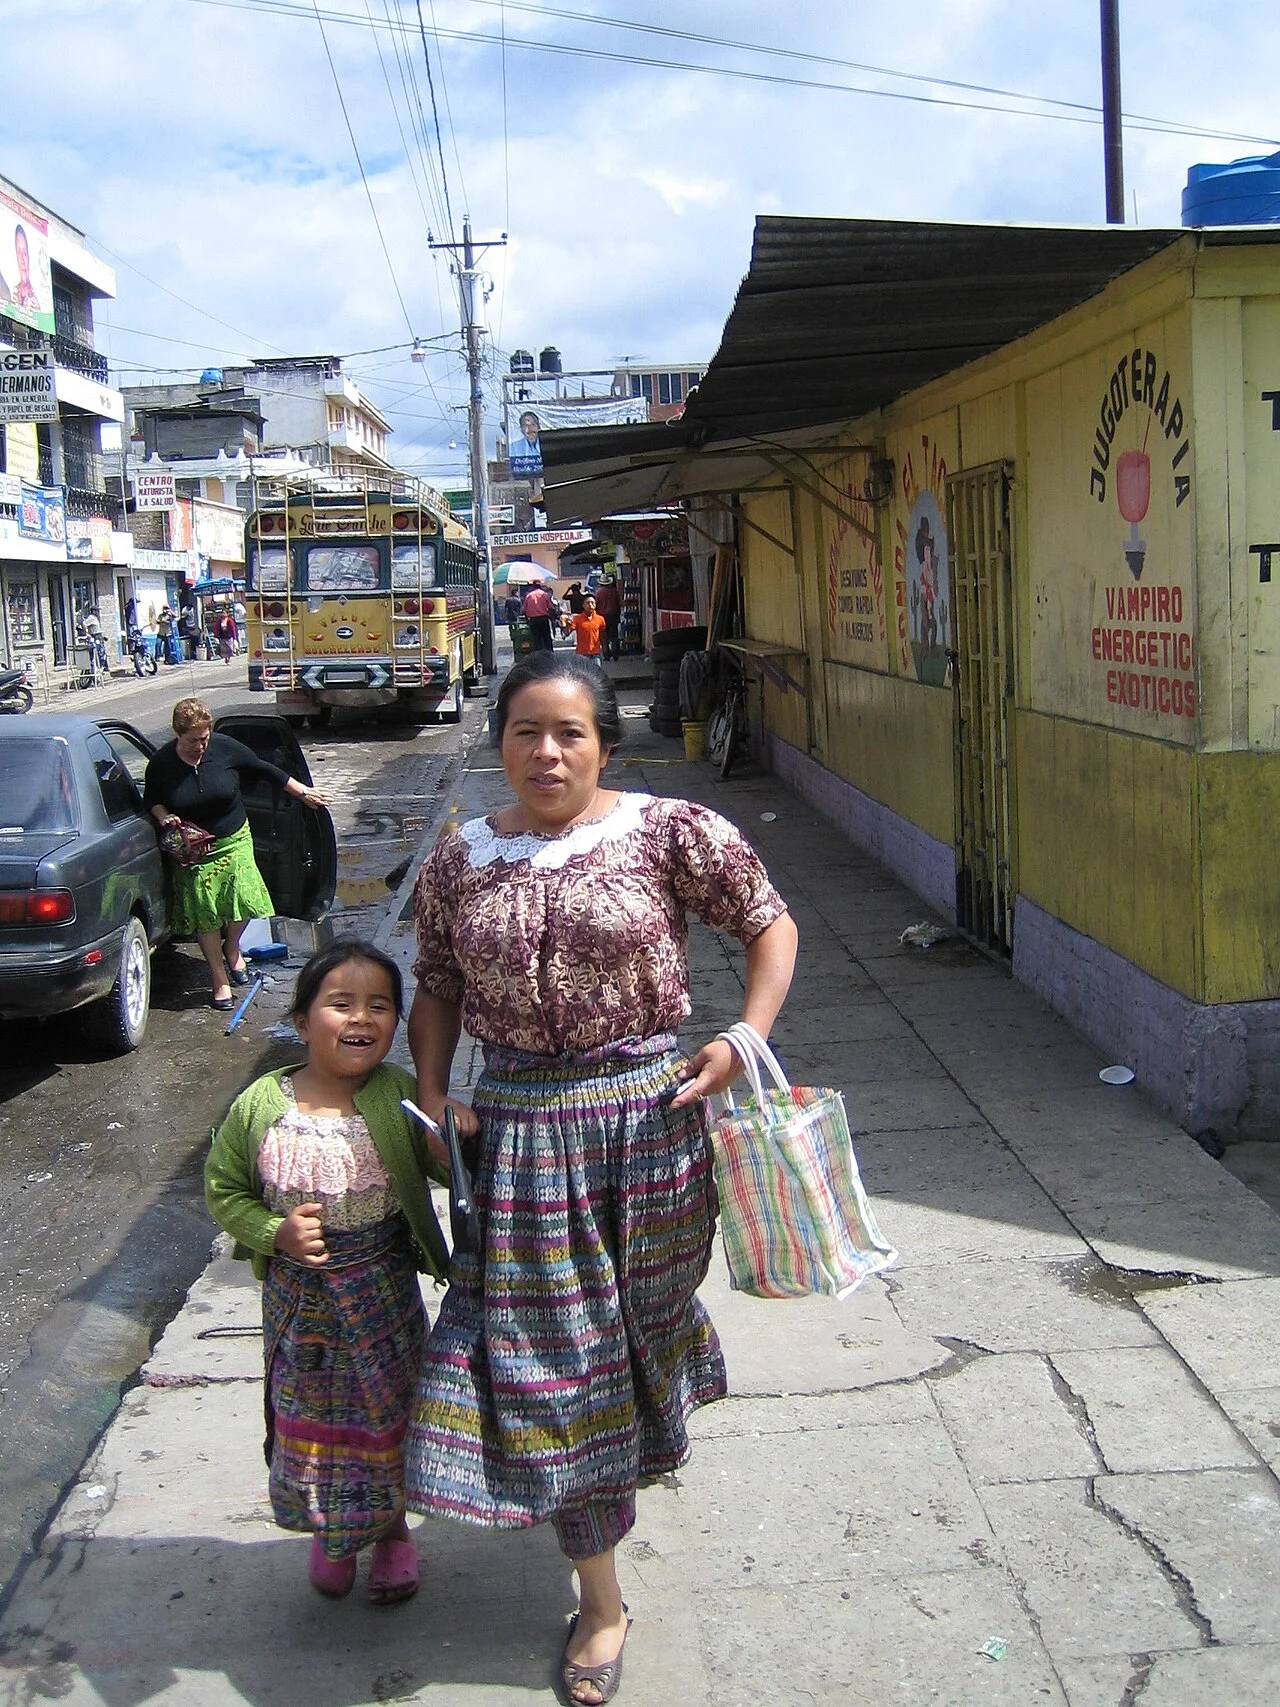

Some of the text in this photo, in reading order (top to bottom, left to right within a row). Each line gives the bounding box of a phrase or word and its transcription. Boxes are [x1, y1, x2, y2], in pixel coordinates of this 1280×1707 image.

[0, 354, 48, 370] GEN
[35, 404, 56, 412] REGALO
[1089, 348, 1191, 508] JUGOTERAPIA
[138, 476, 173, 486] CENTRO
[138, 487, 174, 496] NATURISTA
[139, 497, 174, 506] LA SALUD
[494, 534, 539, 545] REPUESTOS
[540, 532, 584, 542] HOSPEDAJE
[1105, 586, 1182, 623] VAMPIRO
[26, 662, 33, 671] E
[1106, 670, 1196, 718] EXOTICOS
